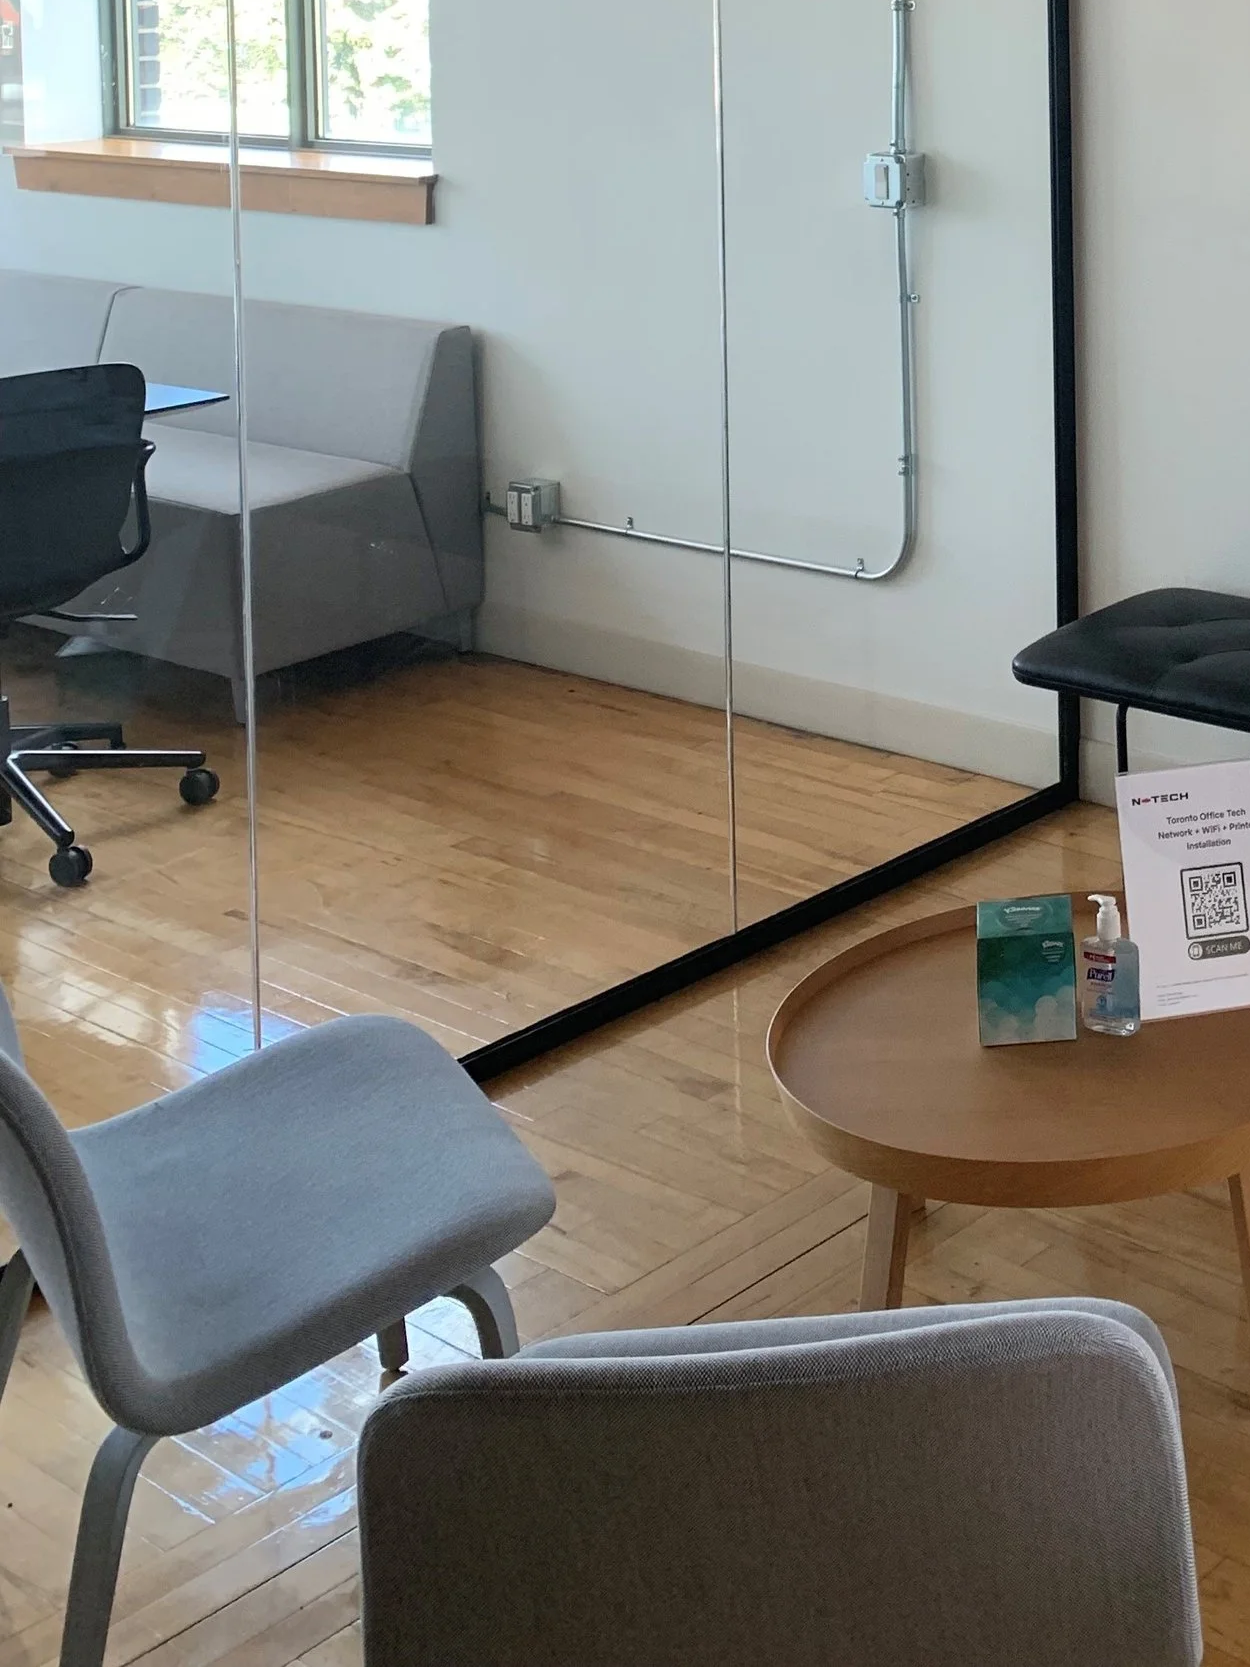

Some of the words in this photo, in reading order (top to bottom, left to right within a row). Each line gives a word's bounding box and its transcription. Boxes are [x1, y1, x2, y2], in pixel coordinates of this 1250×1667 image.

[1166, 814, 1198, 825] Toronto
[1200, 810, 1224, 821] Office
[1227, 808, 1246, 817] Tech
[1158, 828, 1193, 840] Network
[1187, 838, 1231, 850] Installation
[1205, 944, 1228, 955] SCAN
[1229, 941, 1243, 951] ME
[1090, 968, 1113, 982] Purell
